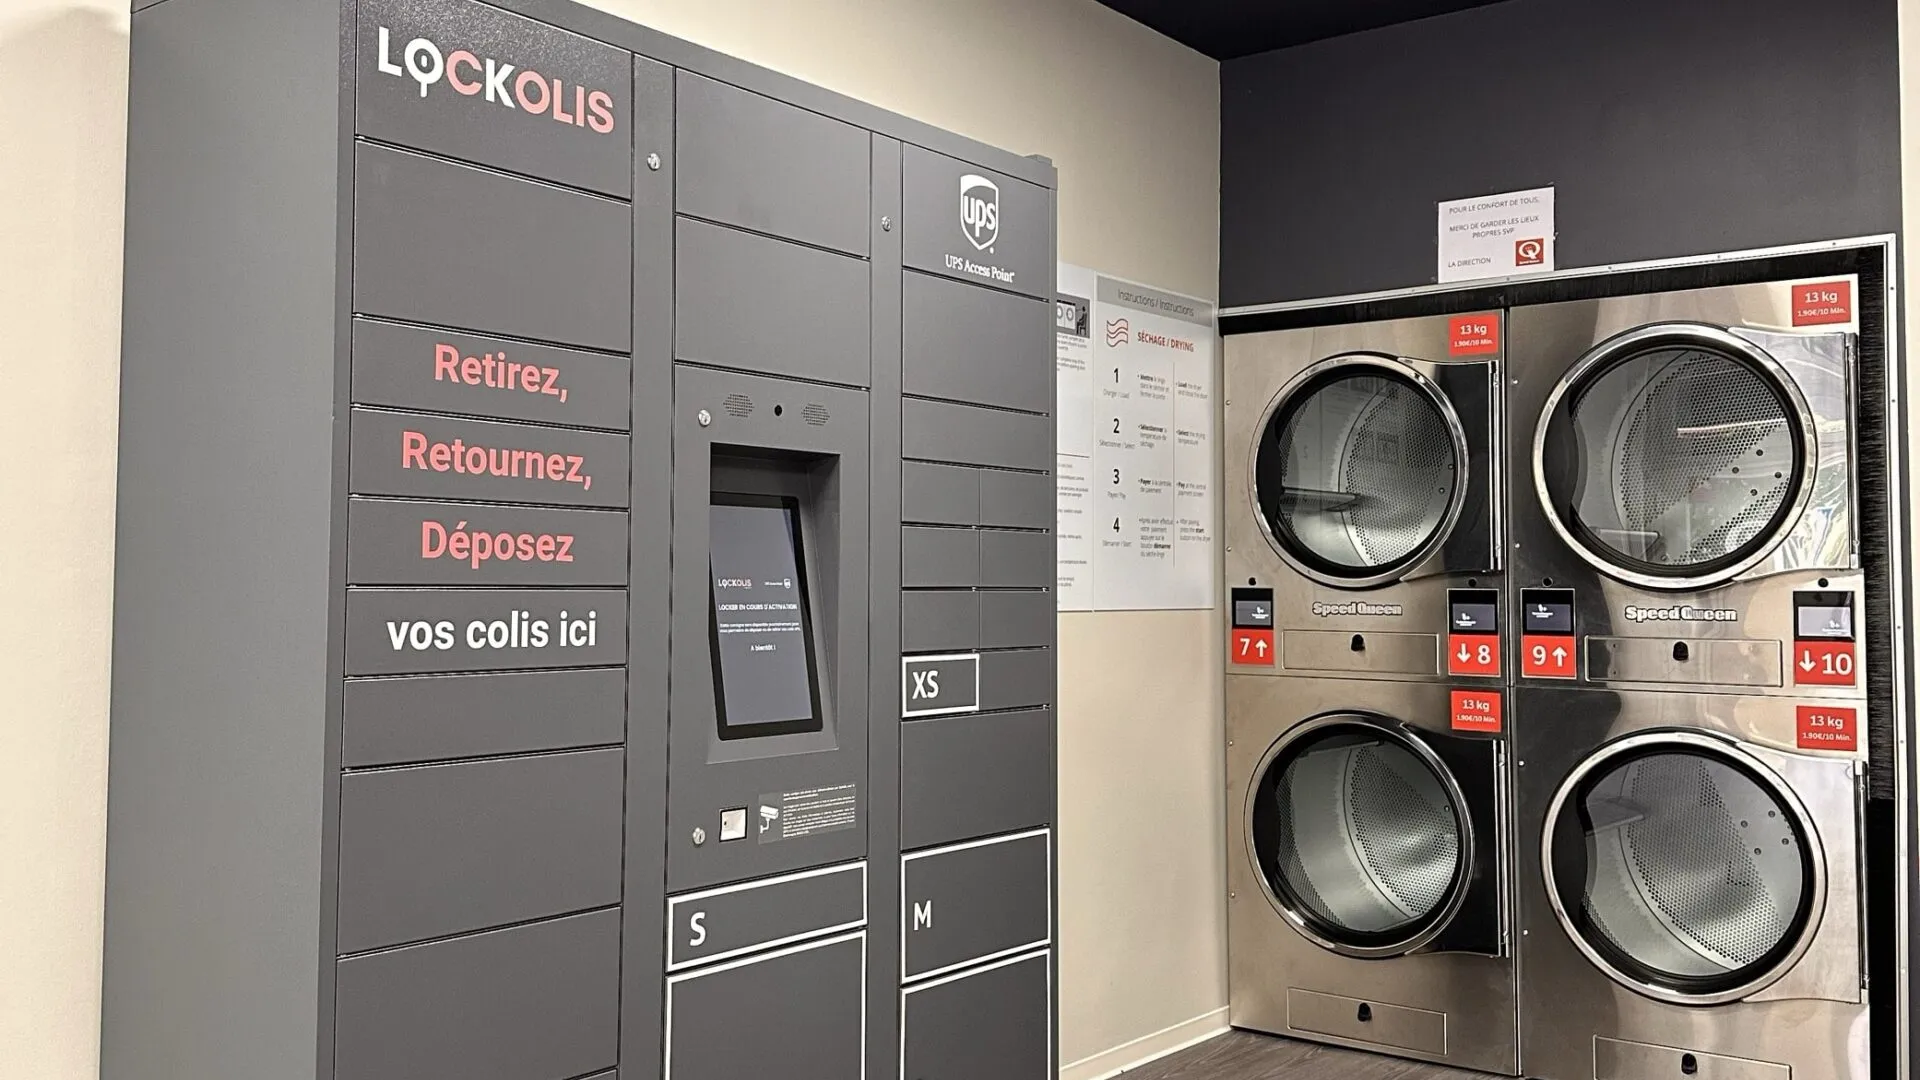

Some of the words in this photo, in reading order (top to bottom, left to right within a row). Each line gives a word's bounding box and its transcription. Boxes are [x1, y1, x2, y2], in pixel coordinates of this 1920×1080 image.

[378, 26, 614, 134] LOCKOLIS
[1449, 206, 1467, 214] POUR
[1468, 204, 1475, 212] LE
[1477, 200, 1508, 211] CONFORT
[1509, 198, 1518, 206] DE
[1449, 224, 1469, 232] MERCI
[1480, 219, 1507, 228] GARDER
[1508, 217, 1519, 225] LES
[1520, 215, 1539, 223] LIEUX
[1472, 229, 1501, 239] PROPRES
[1503, 227, 1515, 235] SVP
[945, 254, 963, 270] UPS
[964, 260, 990, 277] Access
[1448, 260, 1456, 268] LA
[1457, 258, 1491, 267] DIRECTION
[1118, 288, 1154, 308] Instructions
[1159, 299, 1195, 317] Instructions
[1805, 291, 1820, 303] 13
[1821, 290, 1838, 304] kg
[1460, 324, 1472, 335] 13
[1473, 323, 1487, 336] kg
[1137, 329, 1166, 347] SÉCHAGE
[1170, 338, 1194, 353] DRYING
[434, 343, 568, 403] Retirez,
[1113, 367, 1119, 383] 1
[1112, 417, 1120, 434] 2
[402, 431, 591, 490] Retournez,
[1112, 468, 1120, 485] 3
[1112, 517, 1120, 534] 4
[421, 521, 574, 569] Déposez
[1312, 601, 1358, 617] Speed
[1358, 602, 1403, 616] Queen
[1624, 605, 1680, 623] Speed
[1680, 607, 1738, 623] Queen
[387, 620, 456, 651] vos
[466, 610, 549, 650] colis
[559, 610, 597, 648] ici
[1239, 637, 1251, 656] 7
[1477, 644, 1492, 665] 8
[1532, 644, 1547, 666] 9
[1821, 653, 1852, 676] 10
[912, 670, 940, 700] XS
[1462, 699, 1475, 710] 13
[1476, 699, 1490, 713] kg
[1810, 714, 1825, 727] 13
[1827, 715, 1844, 730] kg
[913, 900, 933, 931] M
[689, 912, 707, 946] S
